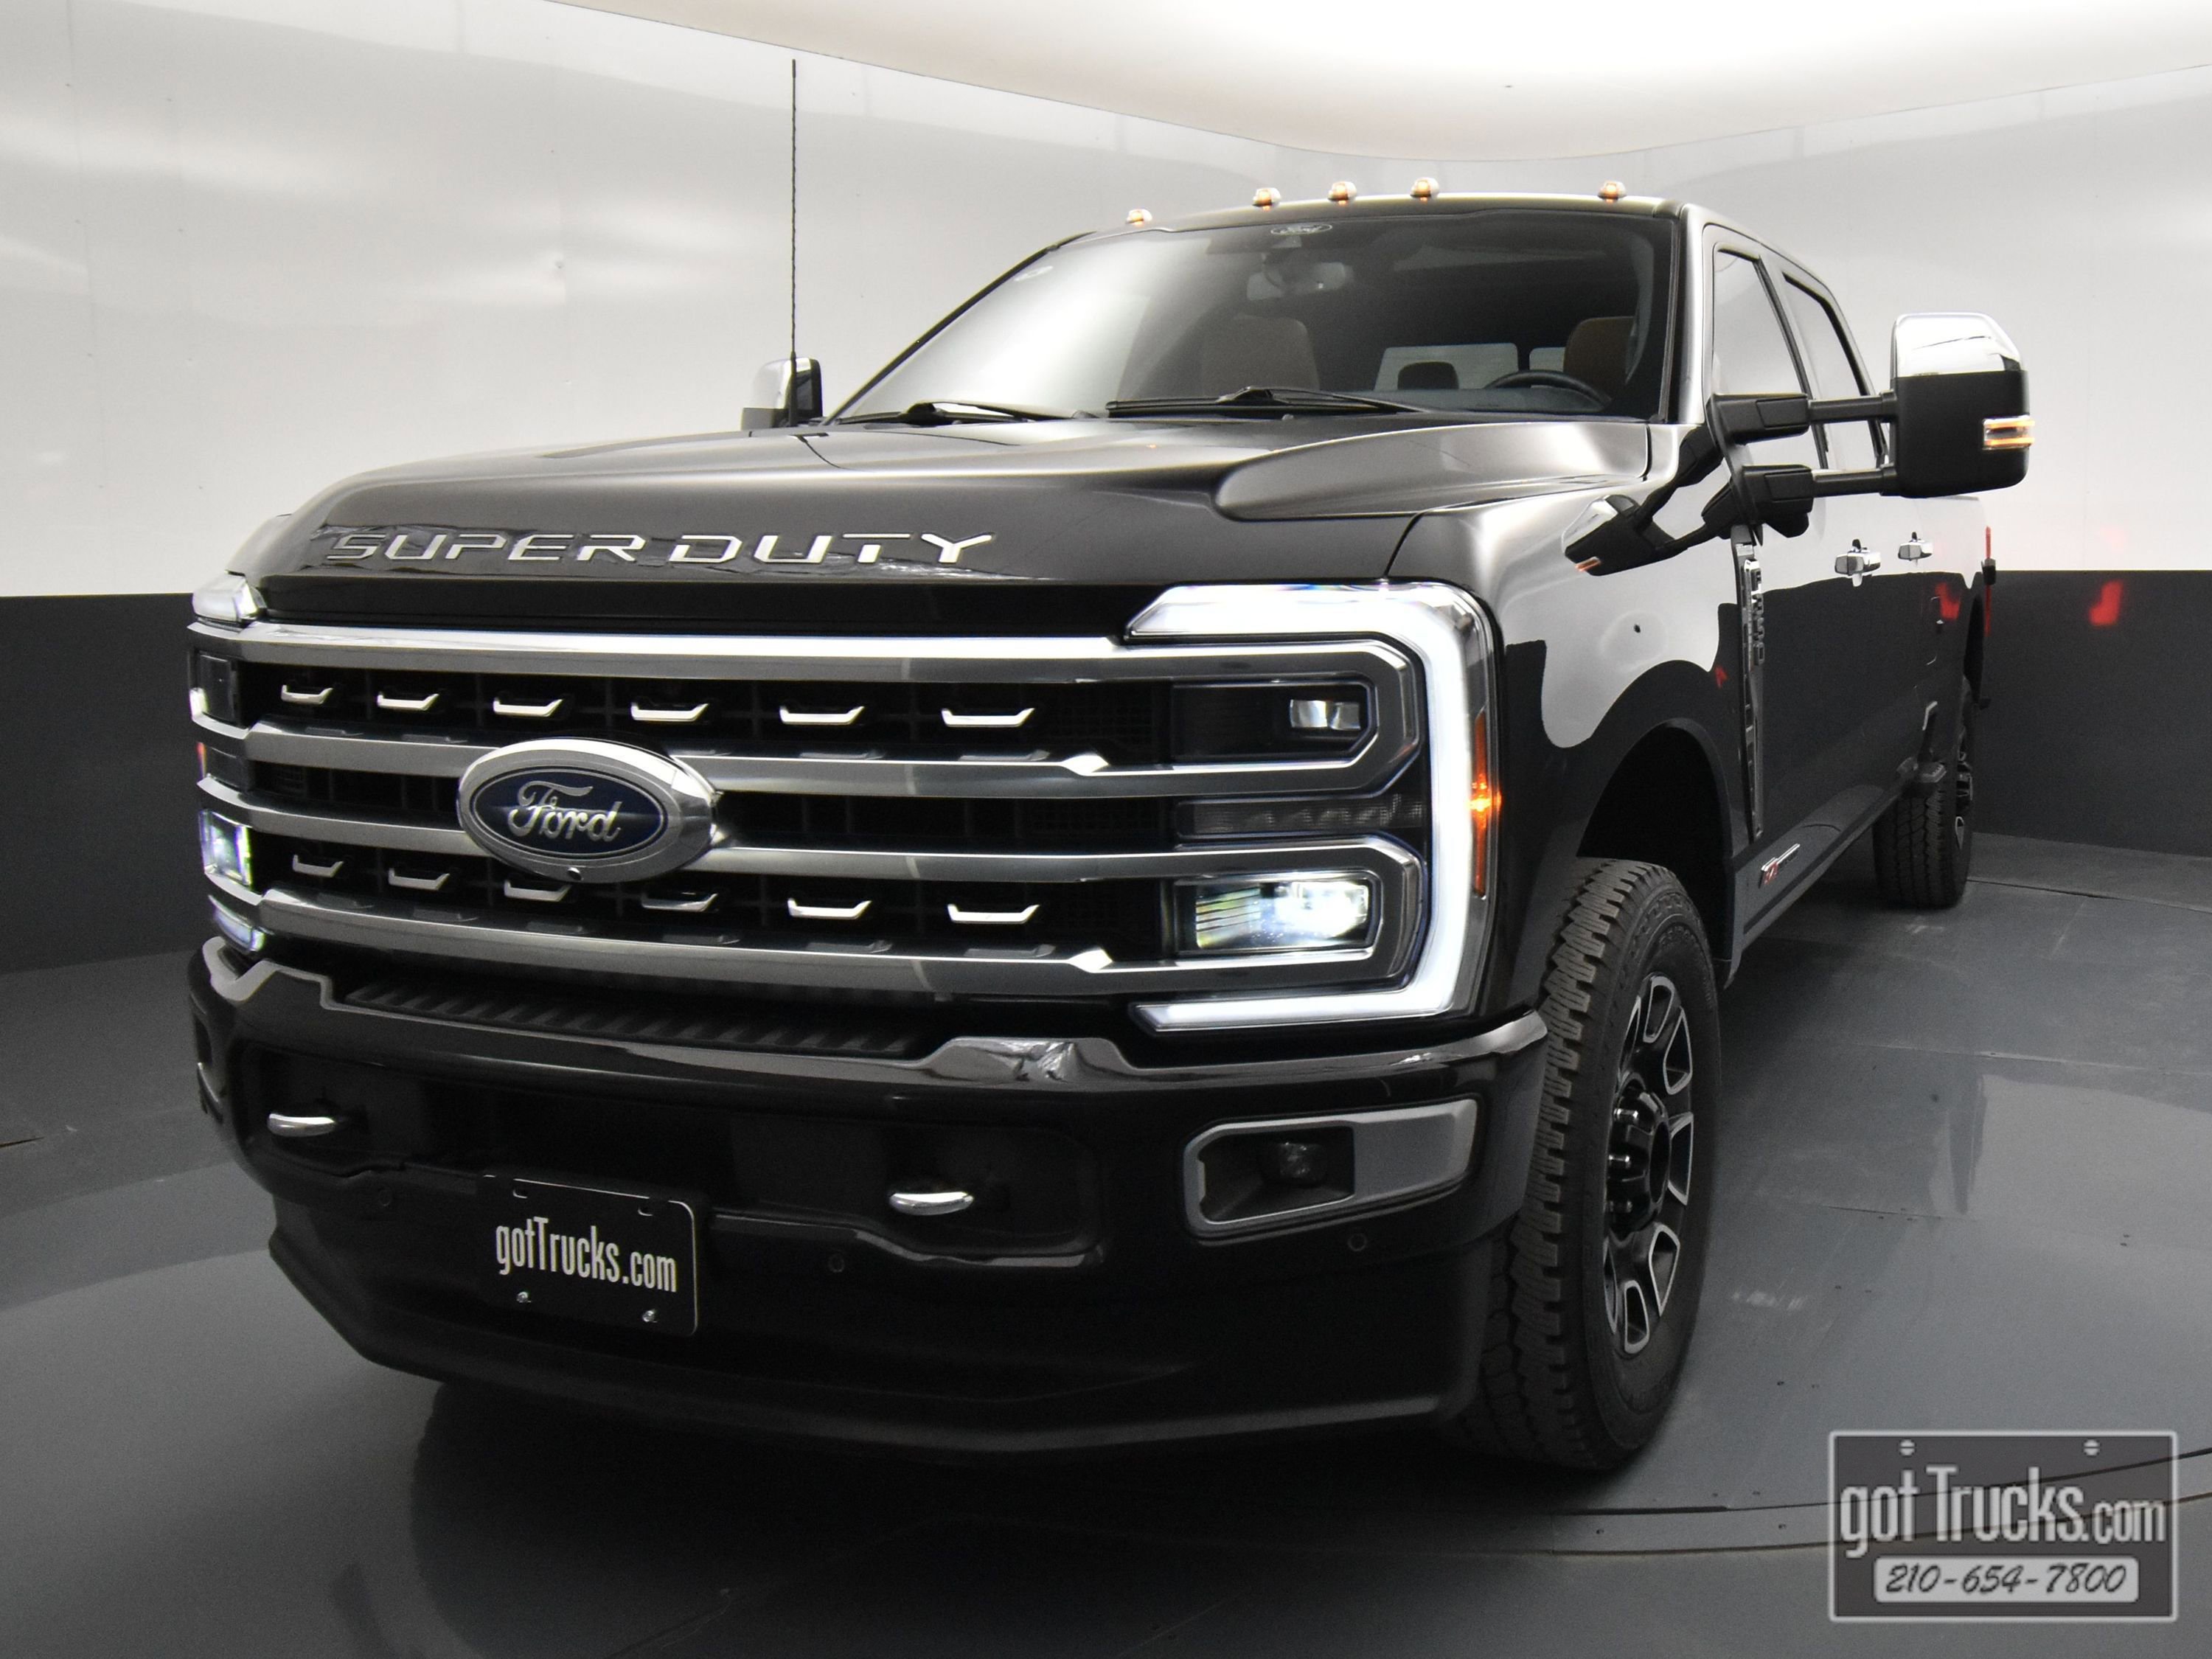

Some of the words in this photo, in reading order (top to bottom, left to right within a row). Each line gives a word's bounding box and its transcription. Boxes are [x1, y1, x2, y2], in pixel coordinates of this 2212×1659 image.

[327, 533, 646, 562] SUPER
[668, 534, 993, 564] DUTY
[507, 780, 623, 842] Ford
[495, 1216, 677, 1293] gotTrucks.com
